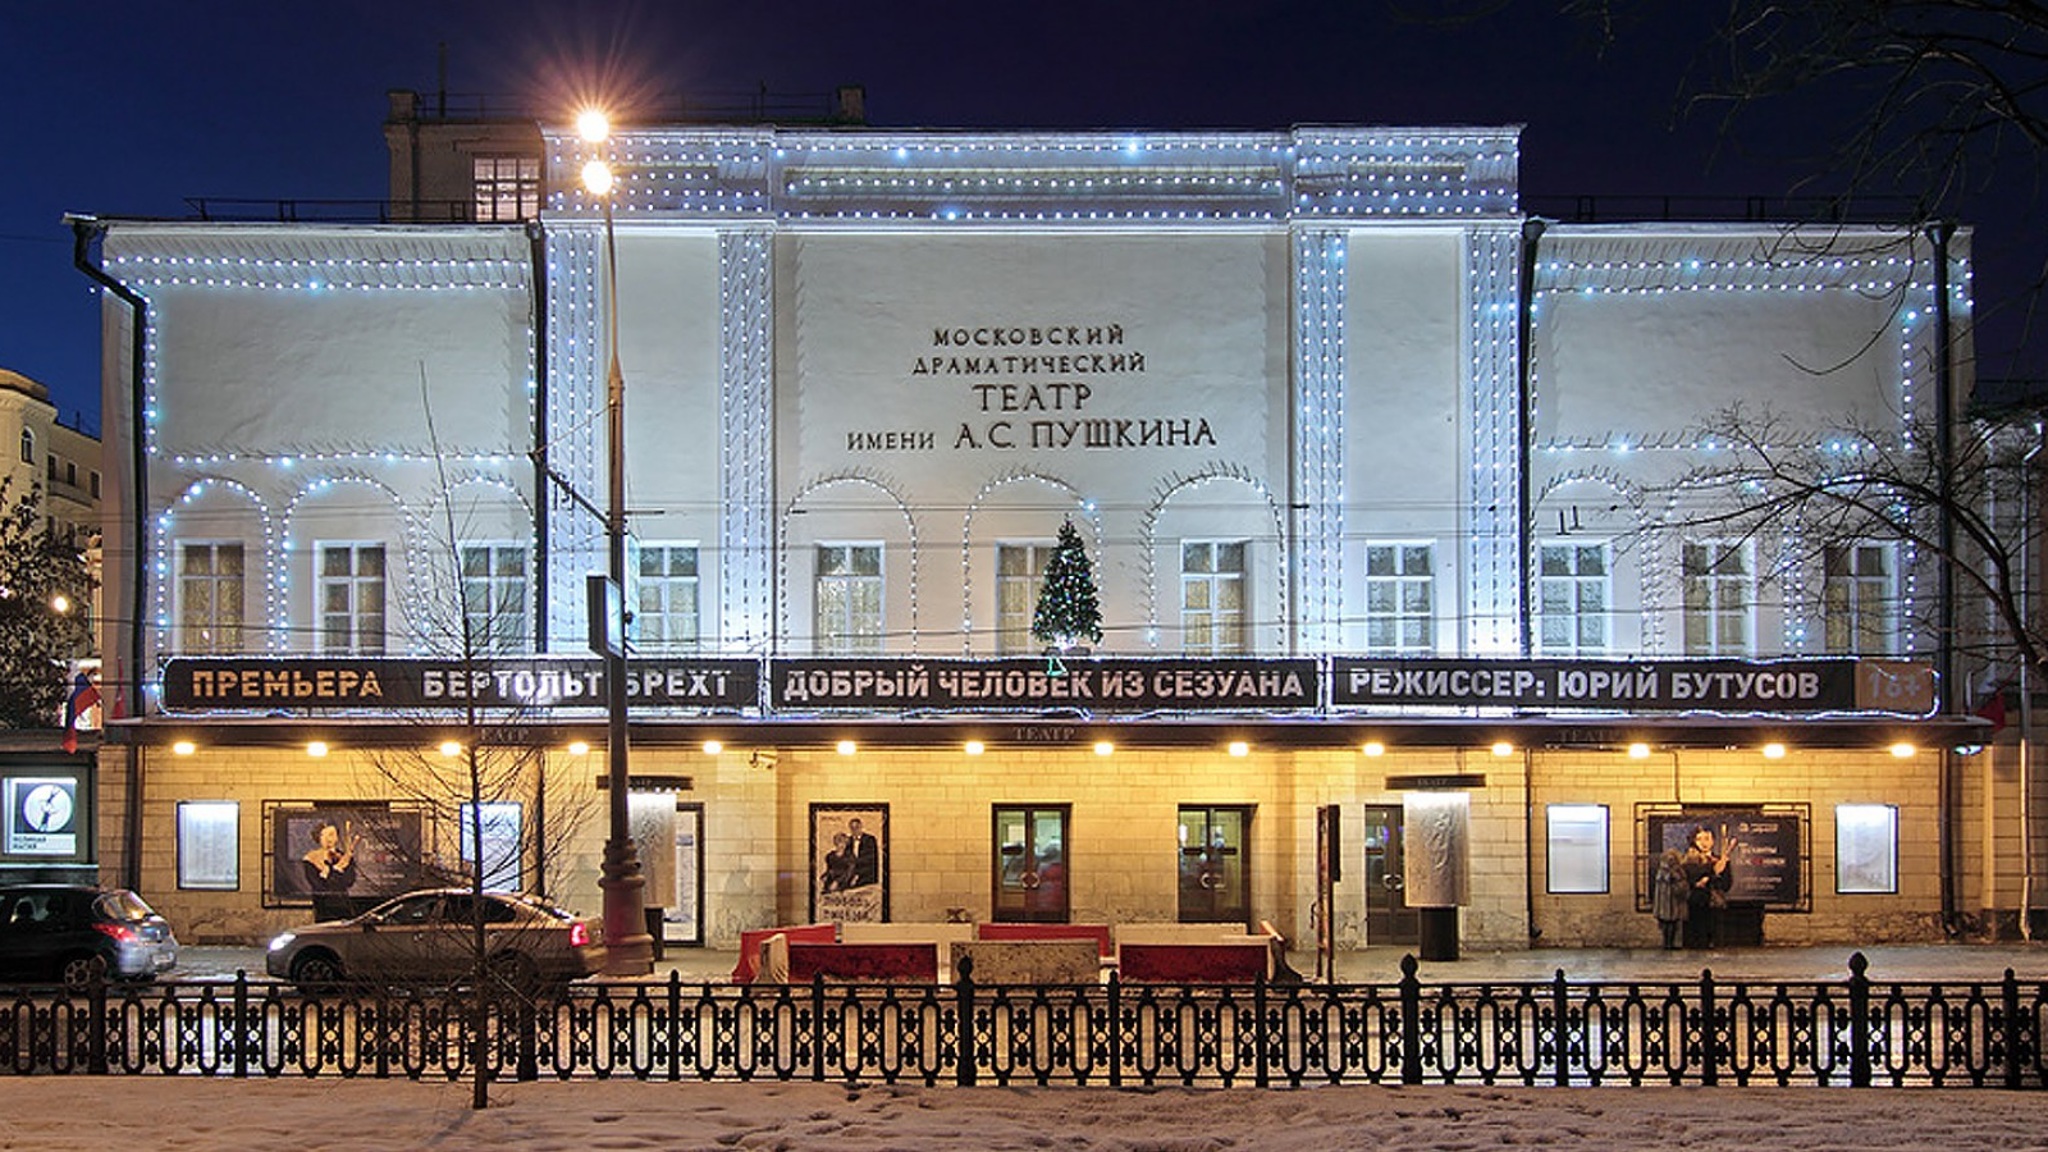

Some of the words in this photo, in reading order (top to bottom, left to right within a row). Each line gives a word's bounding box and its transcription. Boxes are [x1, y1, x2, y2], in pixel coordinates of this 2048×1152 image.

[933, 324, 1124, 347] МОСКОВСКИЙ
[913, 352, 1146, 375] ДРАМАТИЧЕСКИЙ
[971, 384, 1092, 412] ТЕАТР
[847, 433, 934, 450] ИМЕНИ
[1031, 418, 1217, 448] ПУШКИНА
[192, 670, 383, 698] ПРЕМЬЕРА
[423, 670, 603, 698] БЕРТОЛЬТ
[784, 665, 930, 701] ДОБРЫЙ
[938, 669, 1093, 697] ЧЕЛОВЕК
[1102, 670, 1145, 697] ИЗ
[1153, 669, 1304, 697] СЕЗУАНА
[1349, 669, 1546, 697] РЕЖИССЕР:
[1557, 667, 1656, 699] ЮРИЙ
[1671, 671, 1820, 700] БУТУСОВ
[1013, 726, 1075, 740] ТЕАТР
